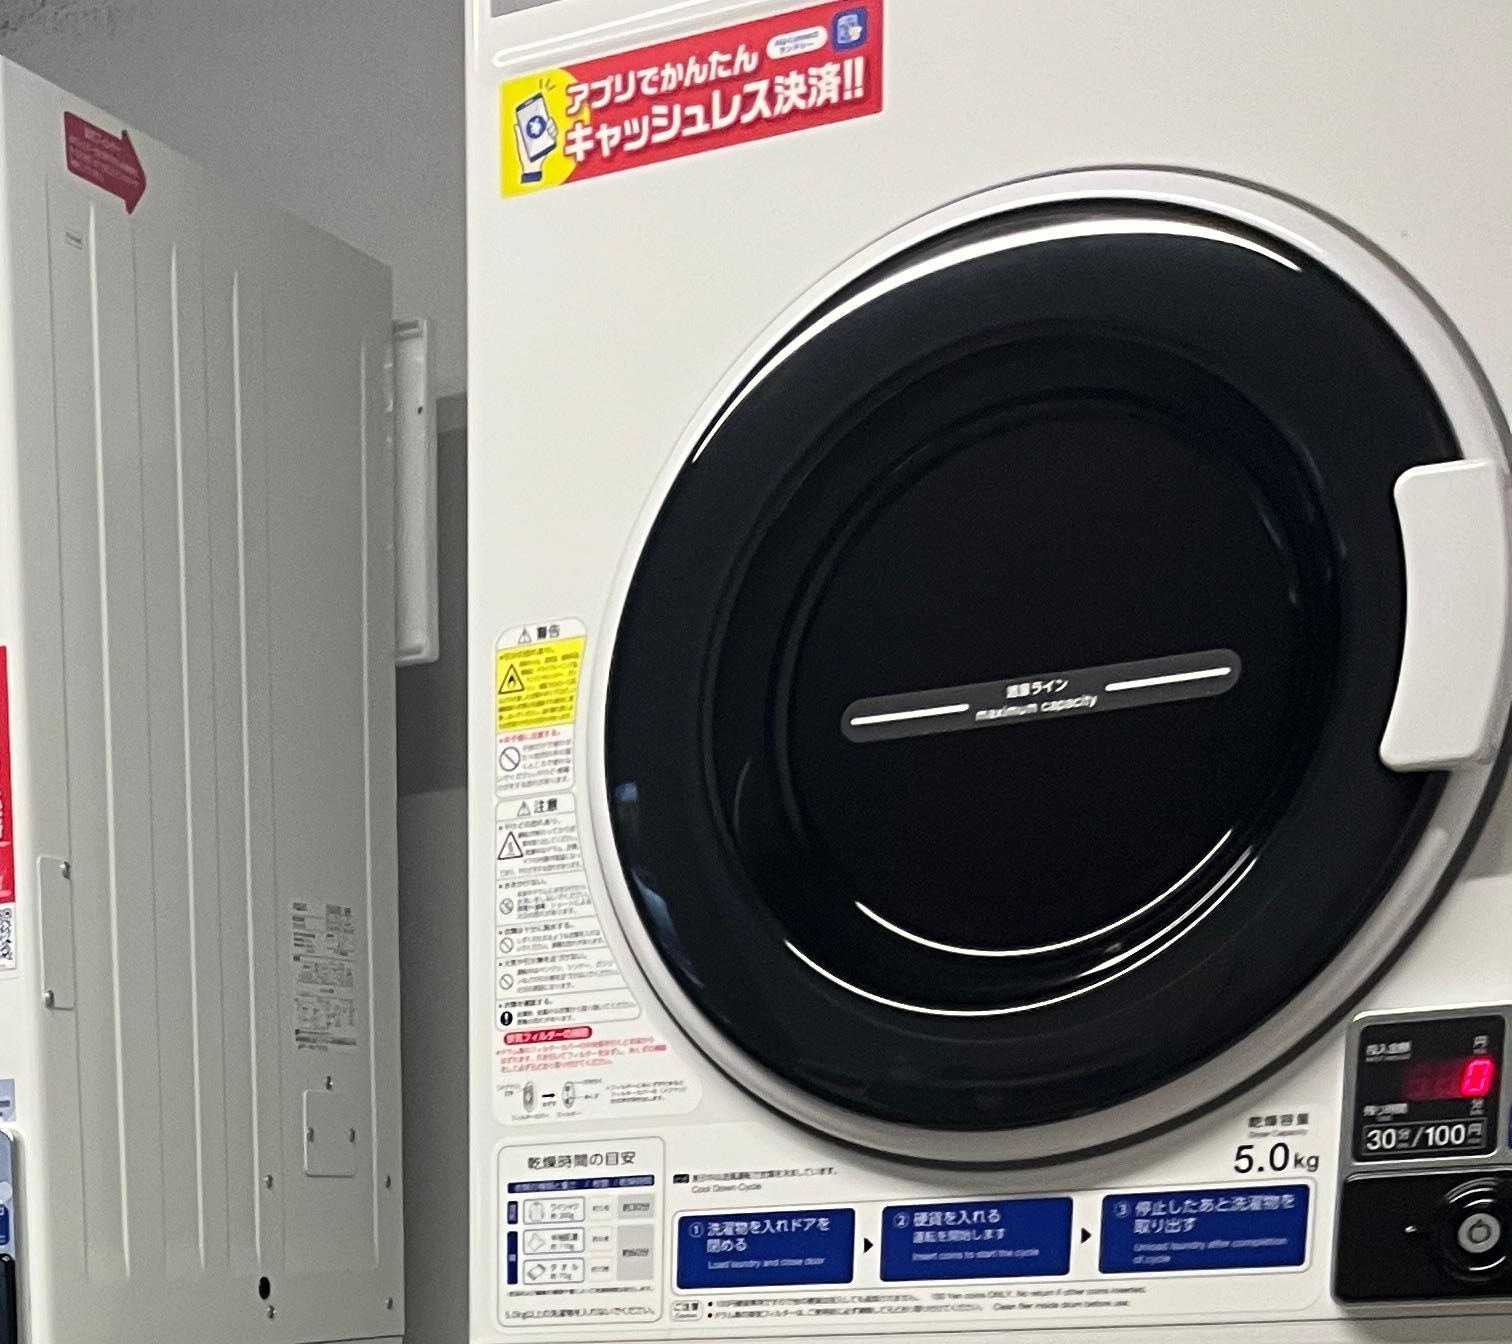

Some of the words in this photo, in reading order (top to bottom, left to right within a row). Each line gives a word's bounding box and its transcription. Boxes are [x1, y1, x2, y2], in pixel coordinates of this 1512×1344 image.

[565, 44, 759, 116] アプリでかんたん
[564, 56, 865, 161] キャッシュレス決済!!
[976, 703, 1038, 720] maximum
[1041, 694, 1098, 712] capacity
[1462, 1057, 1495, 1097] 0
[527, 1151, 636, 1170] 乾燥時間の目安
[1134, 1193, 1295, 1217] 停止したあと洗濯物を
[707, 1217, 831, 1237] 洗濯物を入れドアを
[913, 1208, 1002, 1227] 硬貨を入れる
[1133, 1217, 1197, 1234] 取り出す
